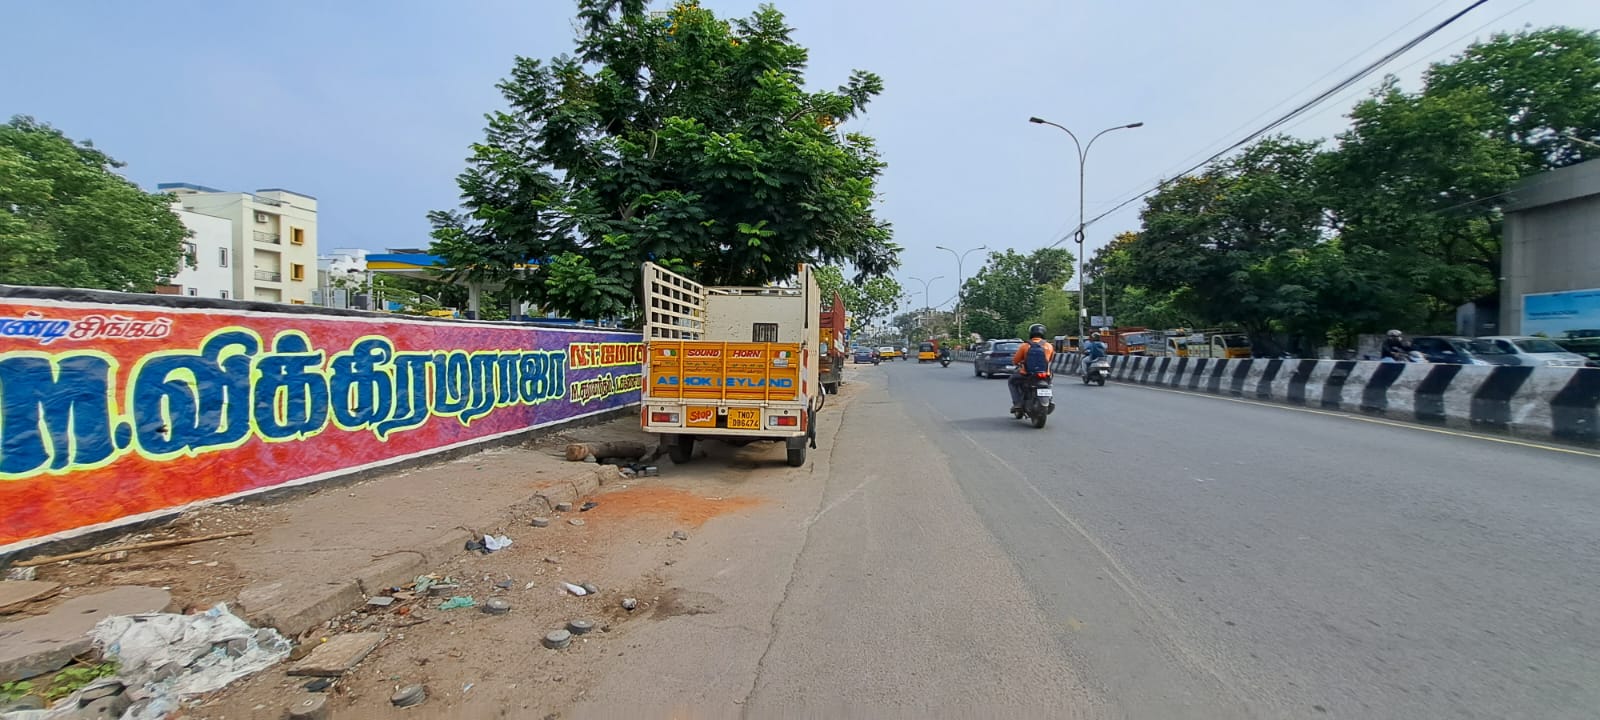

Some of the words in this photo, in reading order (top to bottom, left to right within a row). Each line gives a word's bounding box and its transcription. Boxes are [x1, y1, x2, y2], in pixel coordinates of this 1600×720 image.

[70, 316, 169, 339] சிங்கம்
[688, 349, 720, 358] SOUND
[732, 350, 762, 359] HORN
[657, 376, 713, 387] ASHOK
[717, 377, 793, 388] LEYLAND
[737, 411, 755, 419] TN07
